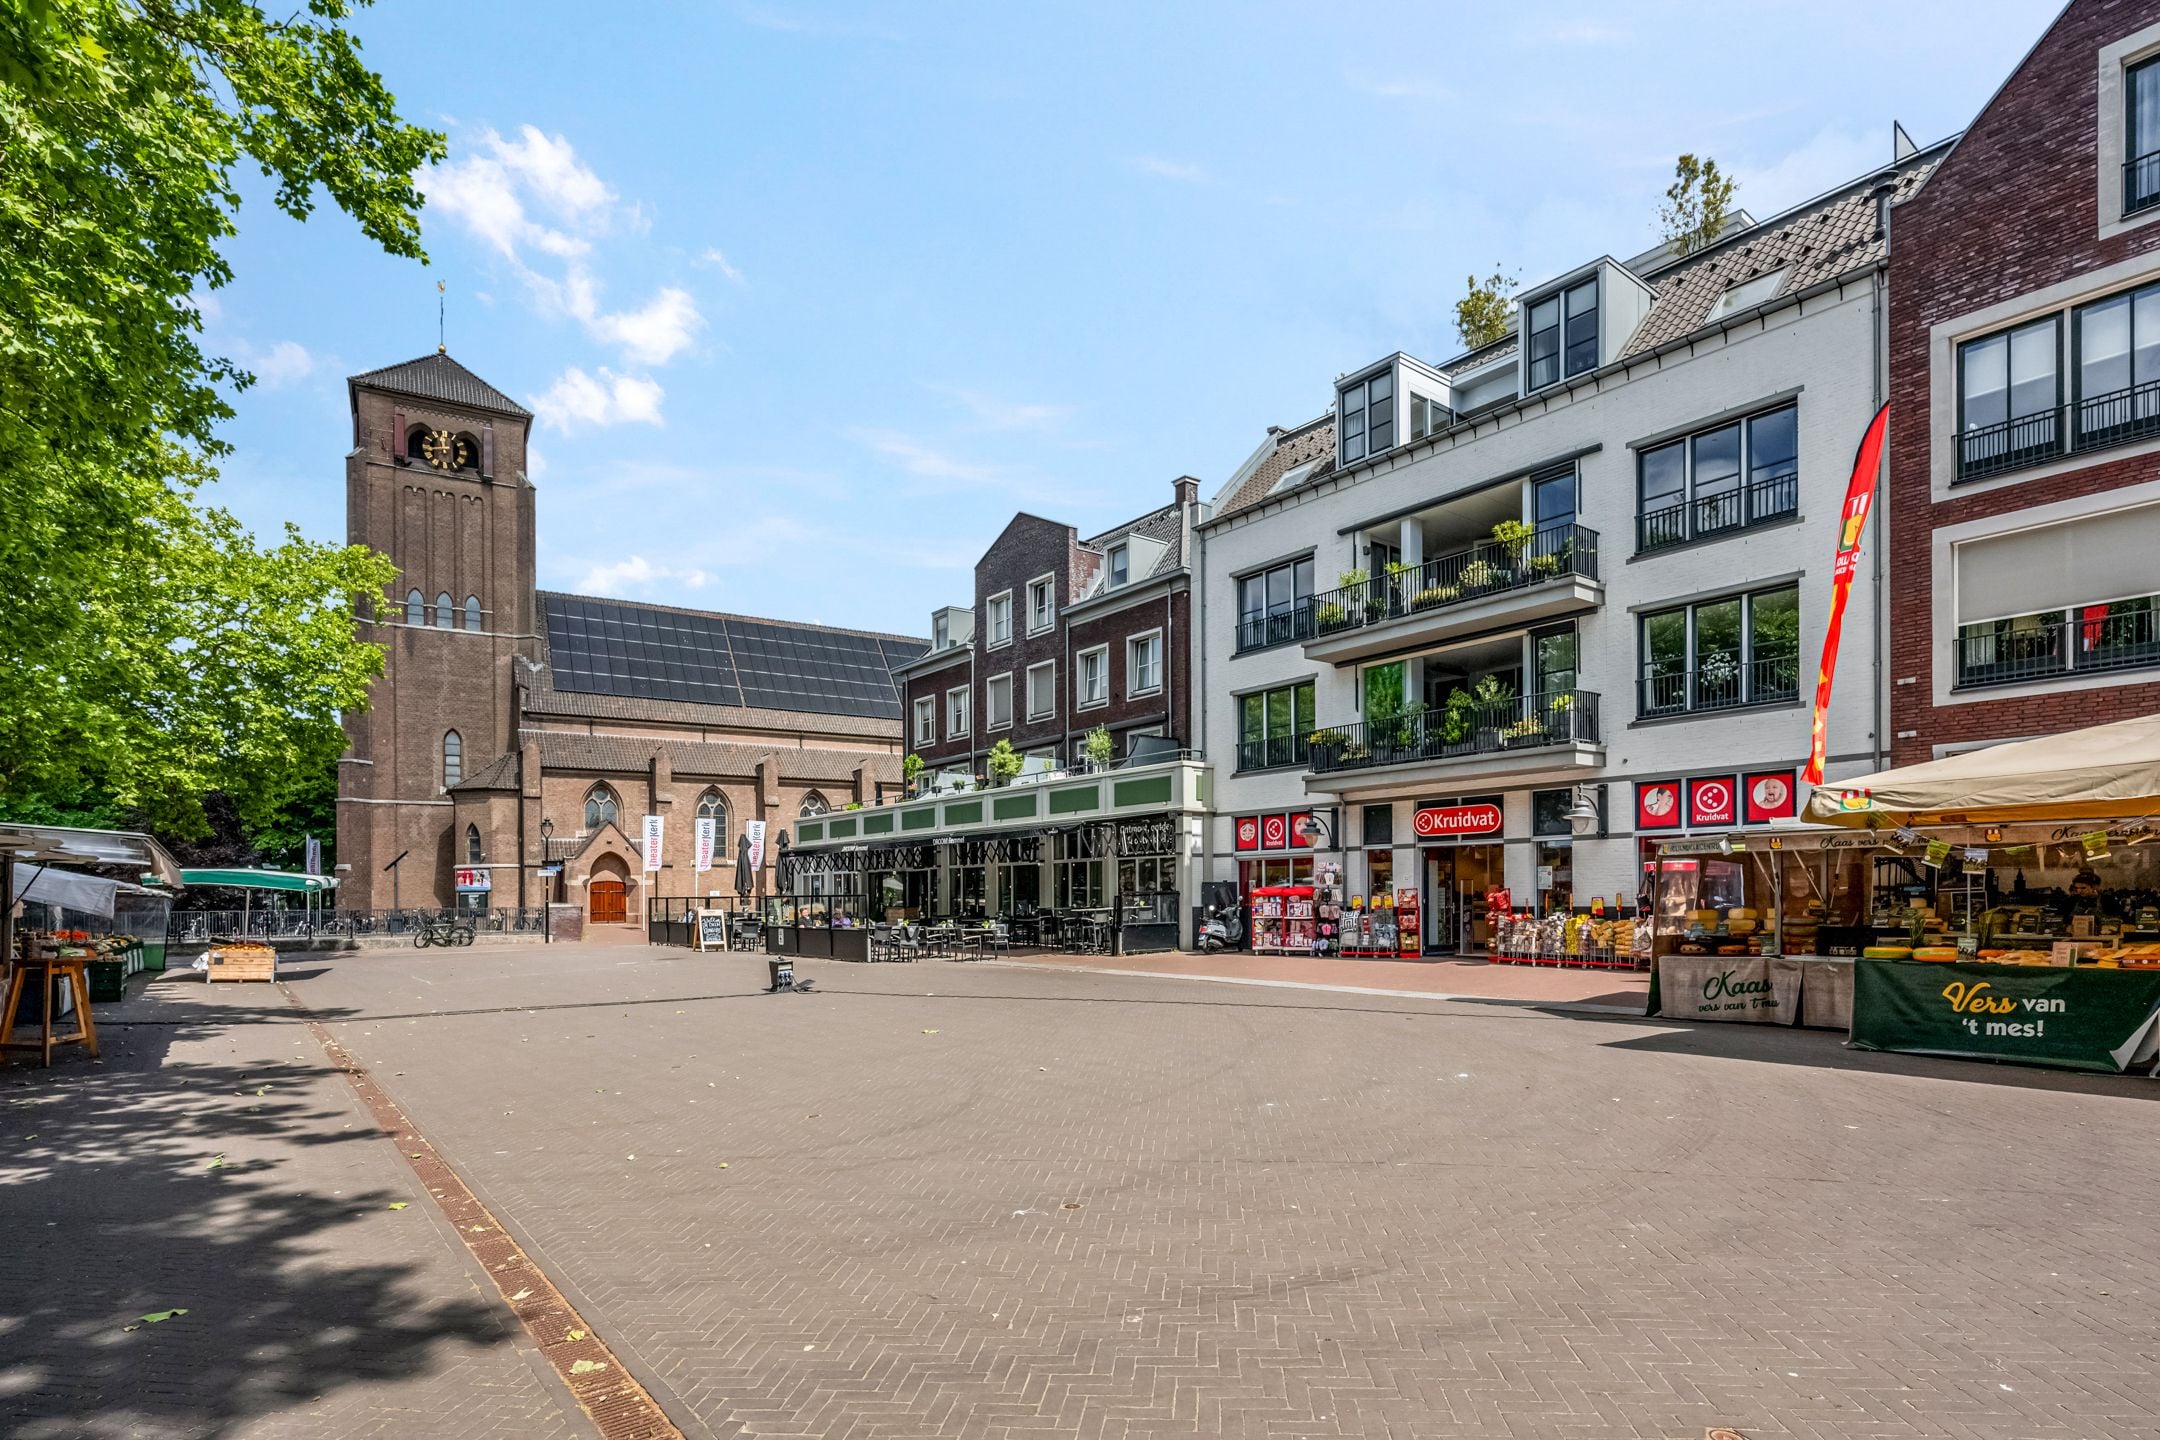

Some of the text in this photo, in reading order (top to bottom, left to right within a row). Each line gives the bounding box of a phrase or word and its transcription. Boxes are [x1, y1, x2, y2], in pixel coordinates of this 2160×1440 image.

[1433, 811, 1495, 829] Kruidvat
[1696, 813, 1729, 821] Kruidvat
[649, 819, 659, 867] TheaterKerk
[700, 821, 711, 870] TheaterKerk
[1820, 834, 1854, 848] Kaas
[1857, 838, 1879, 847] vers
[1703, 969, 1773, 1000] Kaas
[1698, 1002, 1720, 1012] vers
[1724, 1001, 1746, 1010] van
[1942, 982, 2066, 1014] Vers van
[1986, 1020, 2044, 1037] mes!
